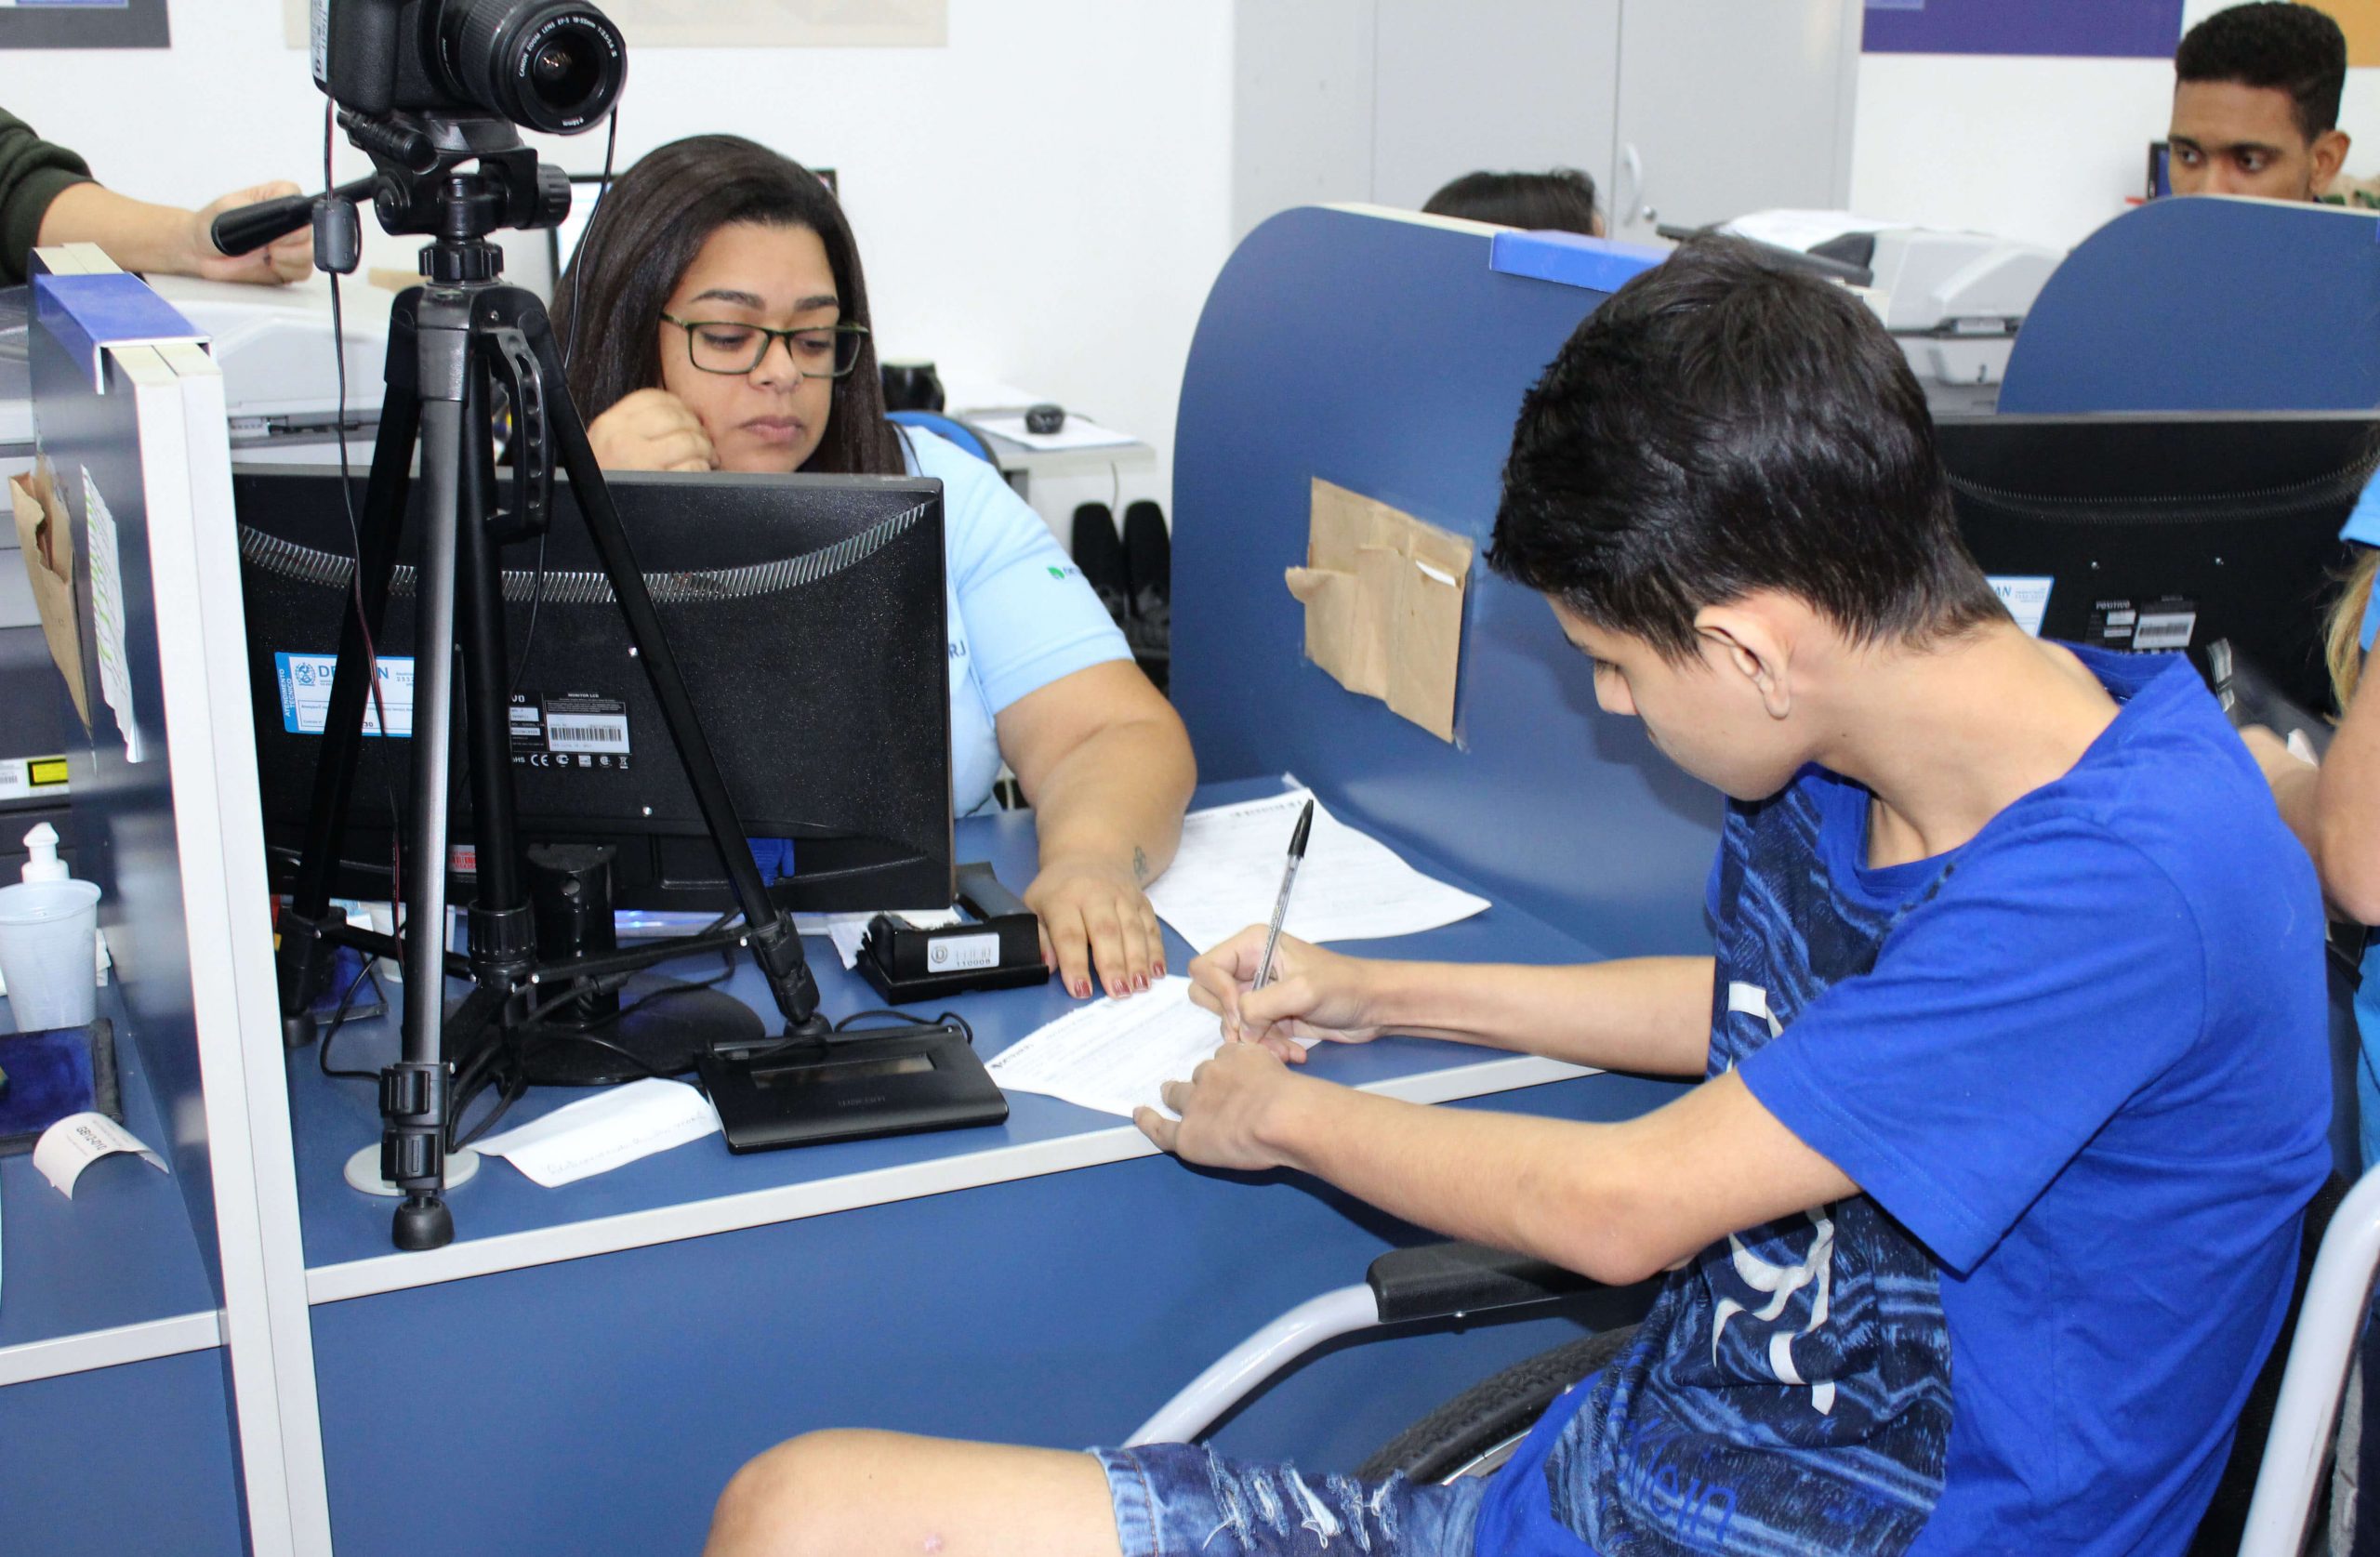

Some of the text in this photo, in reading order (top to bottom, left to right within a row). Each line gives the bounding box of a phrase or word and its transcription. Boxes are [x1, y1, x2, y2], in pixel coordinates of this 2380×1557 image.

[527, 33, 541, 52] ZOOM
[541, 21, 556, 34] LENS
[279, 668, 291, 718] ATENDIMENTO
